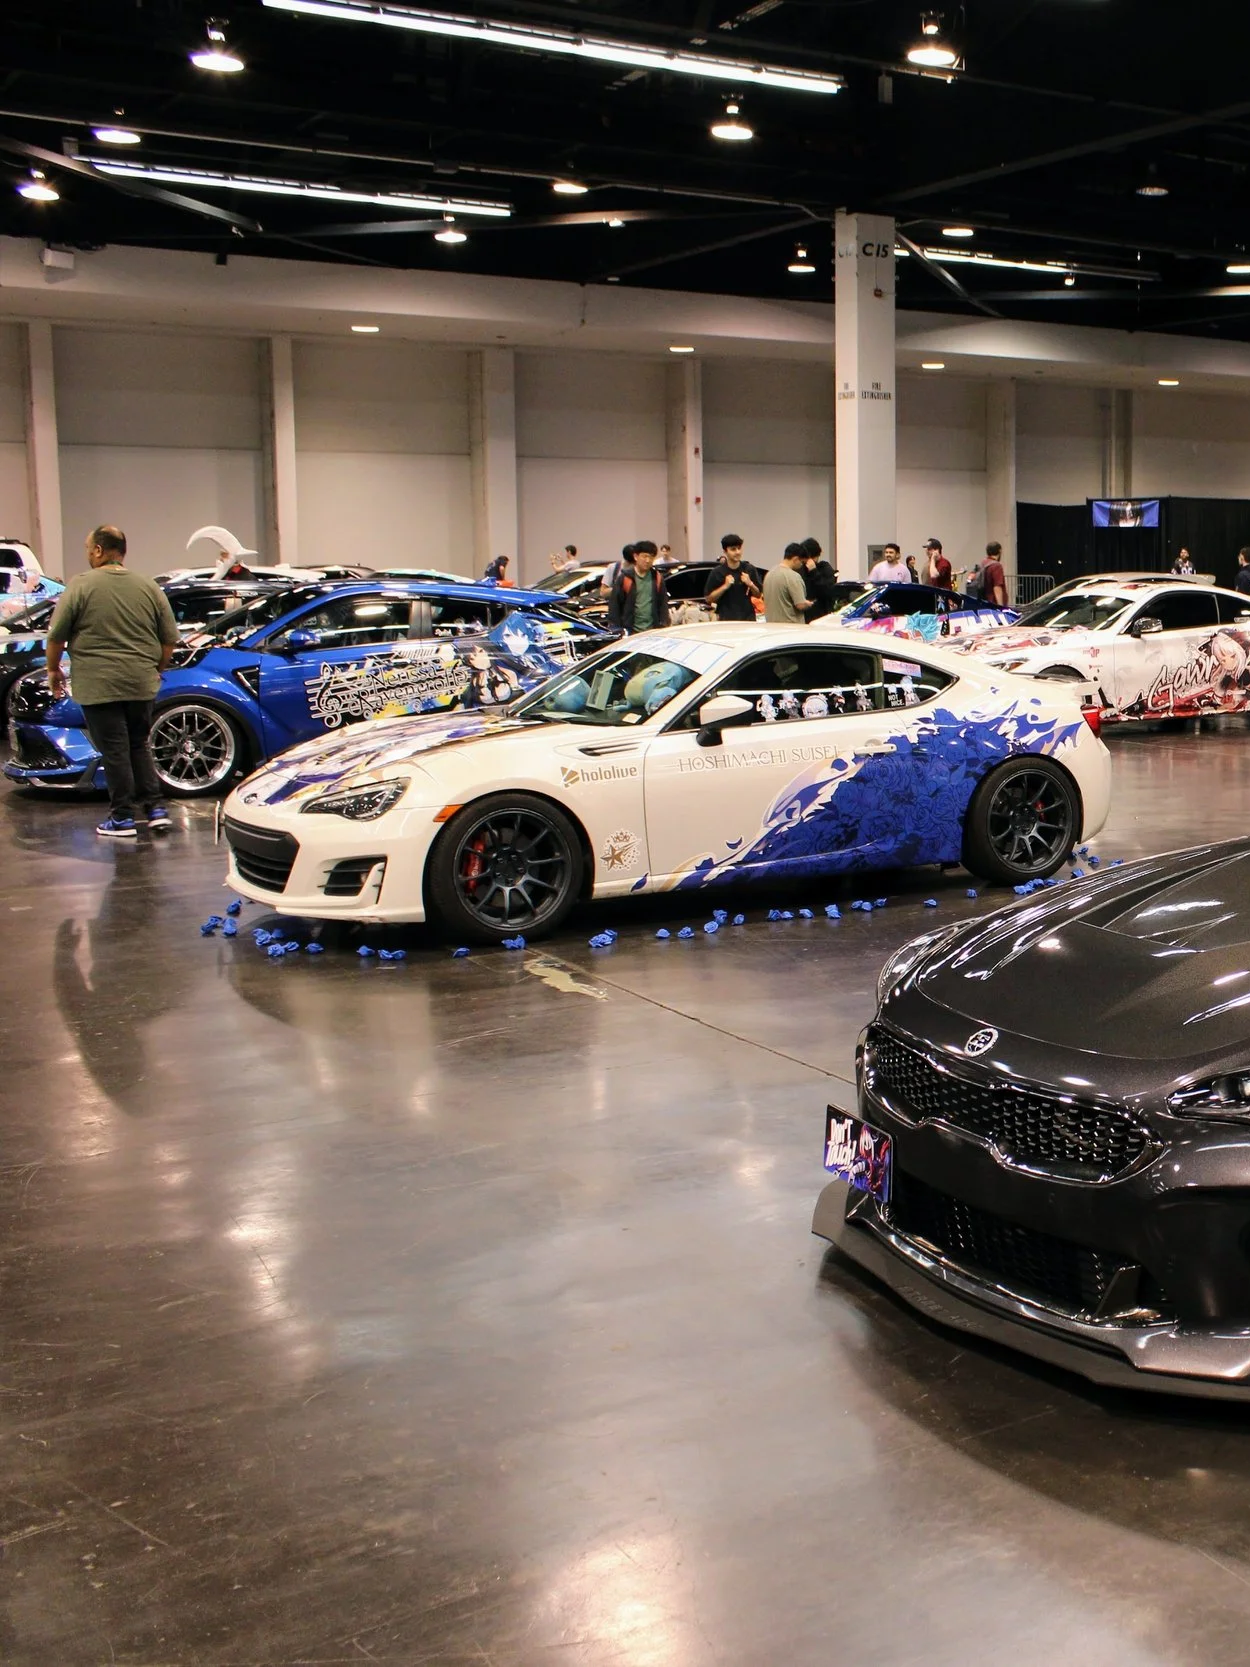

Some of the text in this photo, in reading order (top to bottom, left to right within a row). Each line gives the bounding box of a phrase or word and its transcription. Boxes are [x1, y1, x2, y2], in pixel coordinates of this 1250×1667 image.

[862, 243, 889, 258] C15
[1147, 654, 1219, 712] Gawr
[678, 745, 839, 773] HOSHIMACHI SUISEI
[580, 765, 638, 783] hololive
